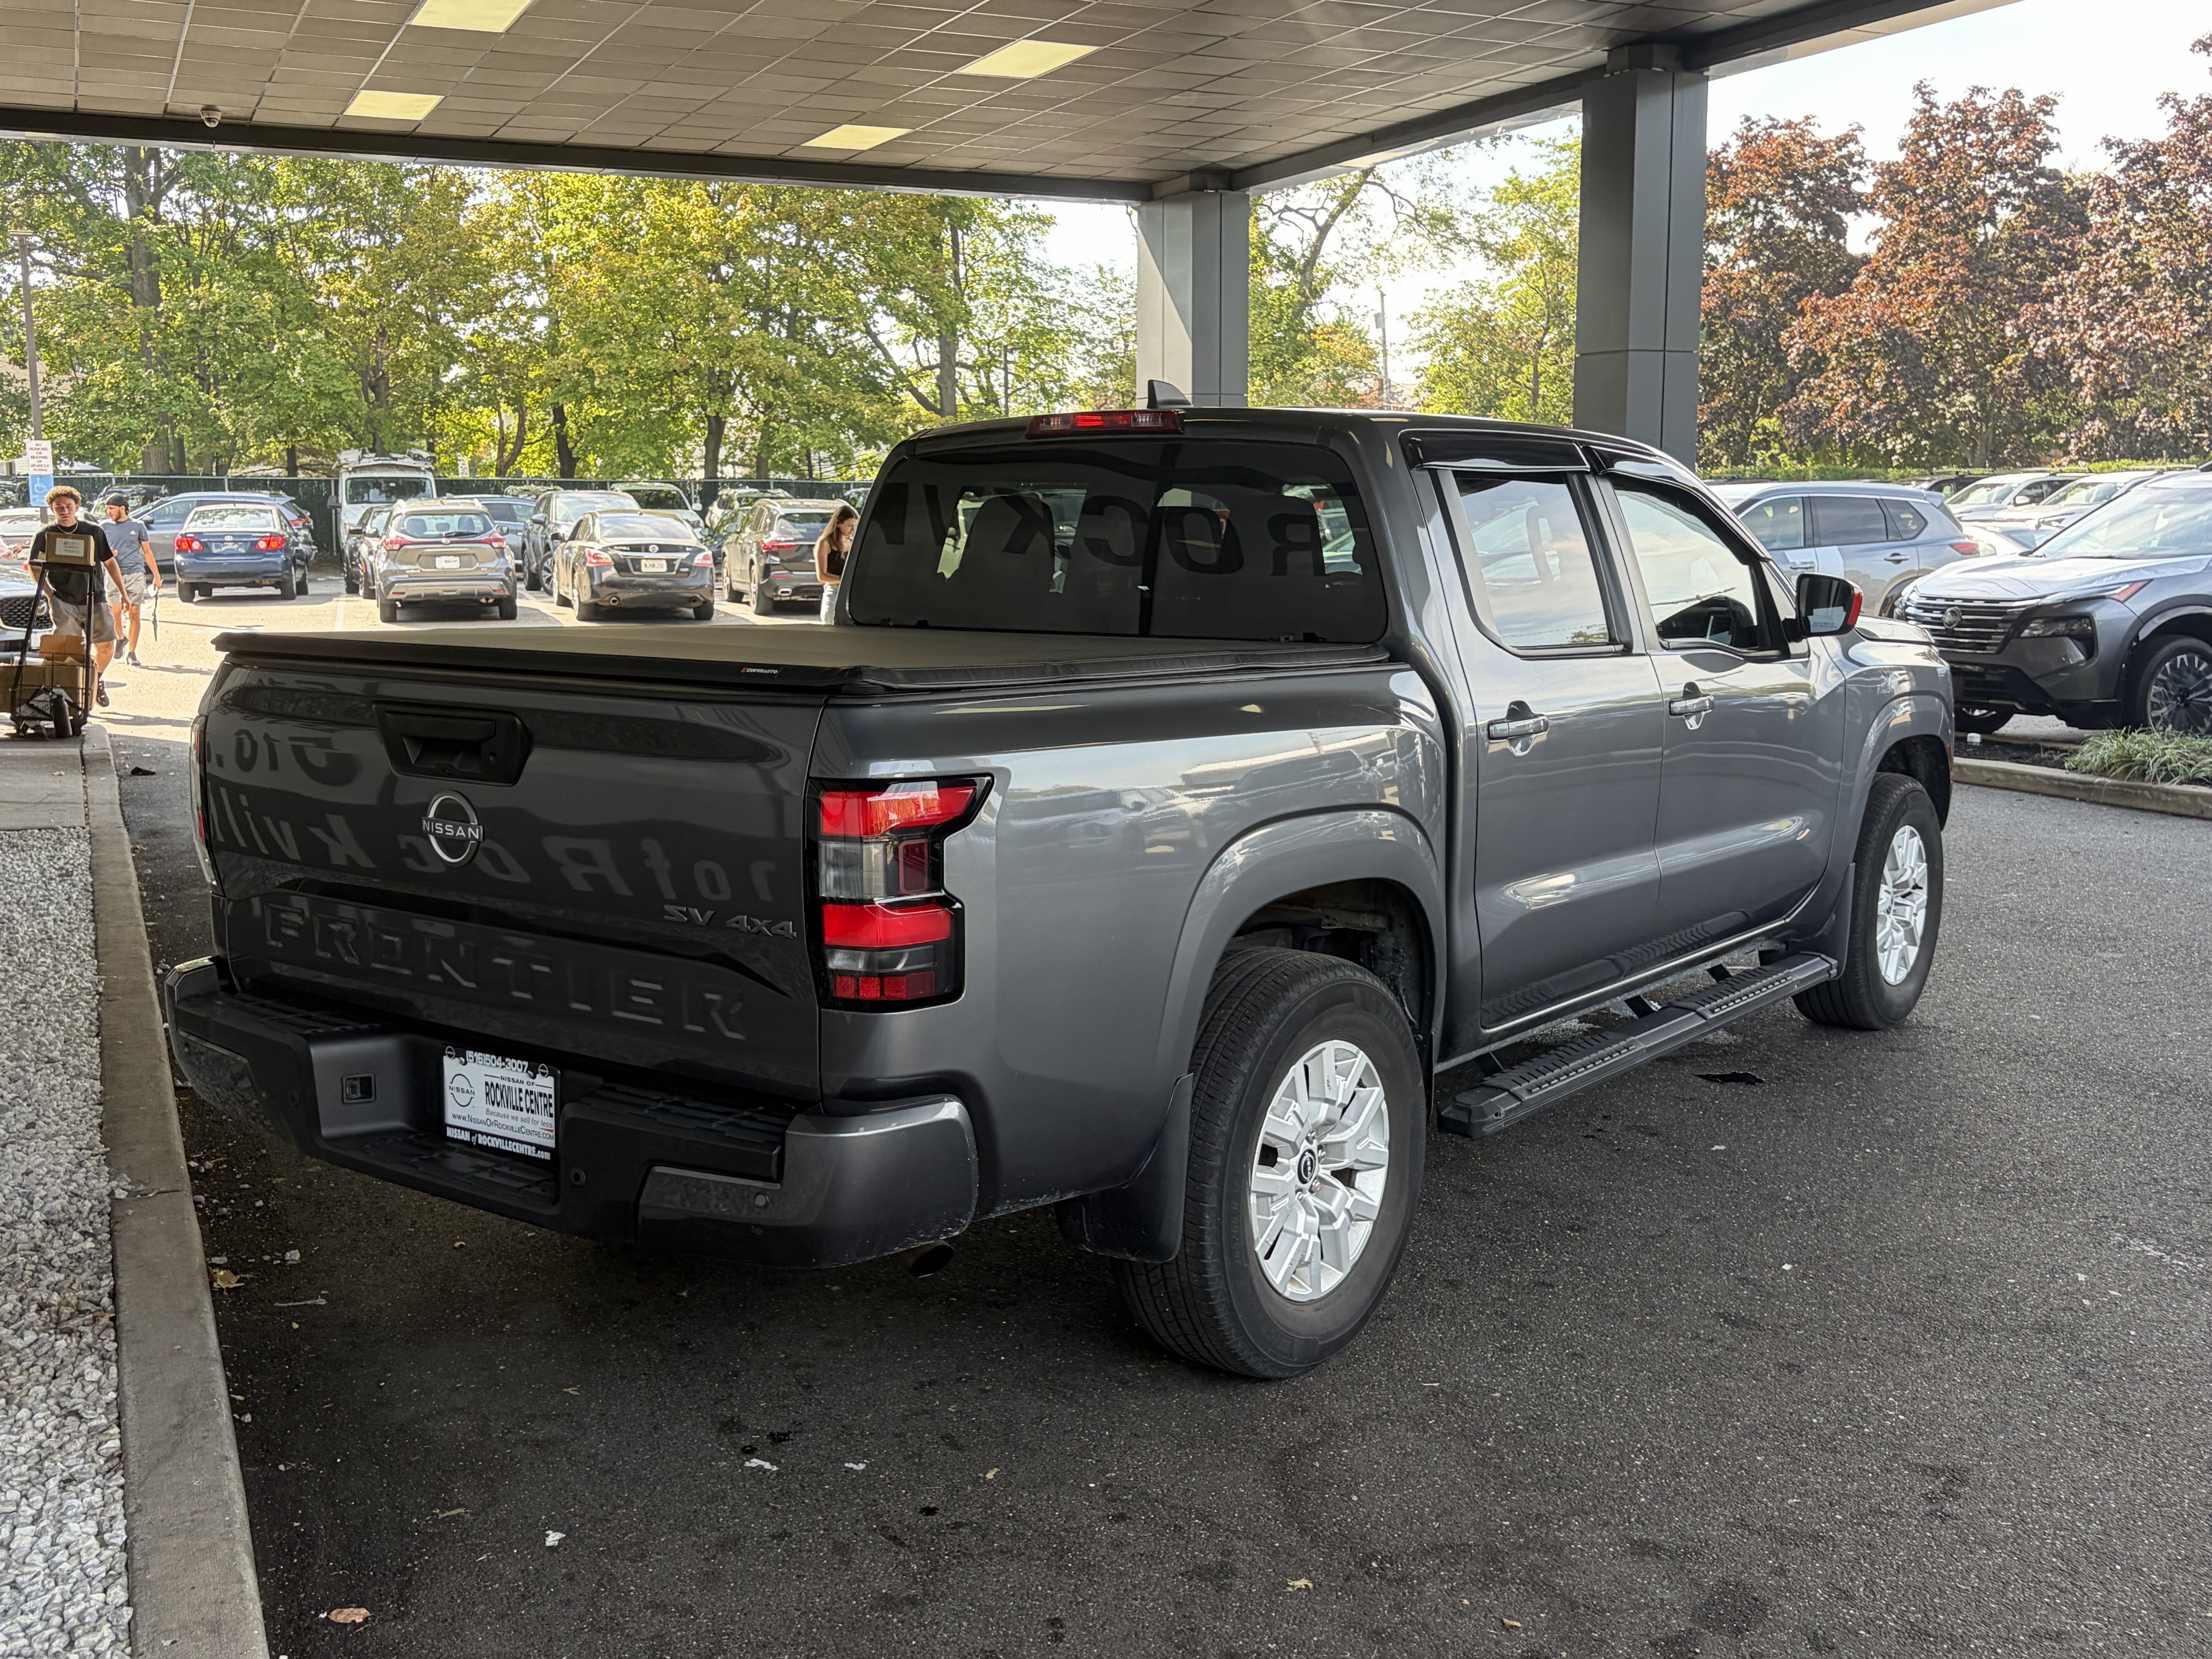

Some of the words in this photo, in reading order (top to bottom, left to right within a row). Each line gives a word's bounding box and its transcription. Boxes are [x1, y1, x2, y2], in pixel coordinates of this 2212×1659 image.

[460, 466, 467, 475] 30
[422, 819, 479, 839] NISSAN
[664, 905, 716, 926] SV
[263, 902, 747, 1041] FRONTIER
[466, 1050, 528, 1073] (516)504-3007
[500, 1075, 524, 1085] NISSAN
[449, 1085, 475, 1096] NISSAN
[485, 1081, 524, 1112] ROCKVILLE
[525, 1089, 553, 1118] CENTRE
[486, 1108, 509, 1119] Because
[447, 1126, 470, 1142] NISSAN
[471, 1133, 477, 1145] of
[478, 1134, 551, 1160] ROCKVILLECENTRE.com
